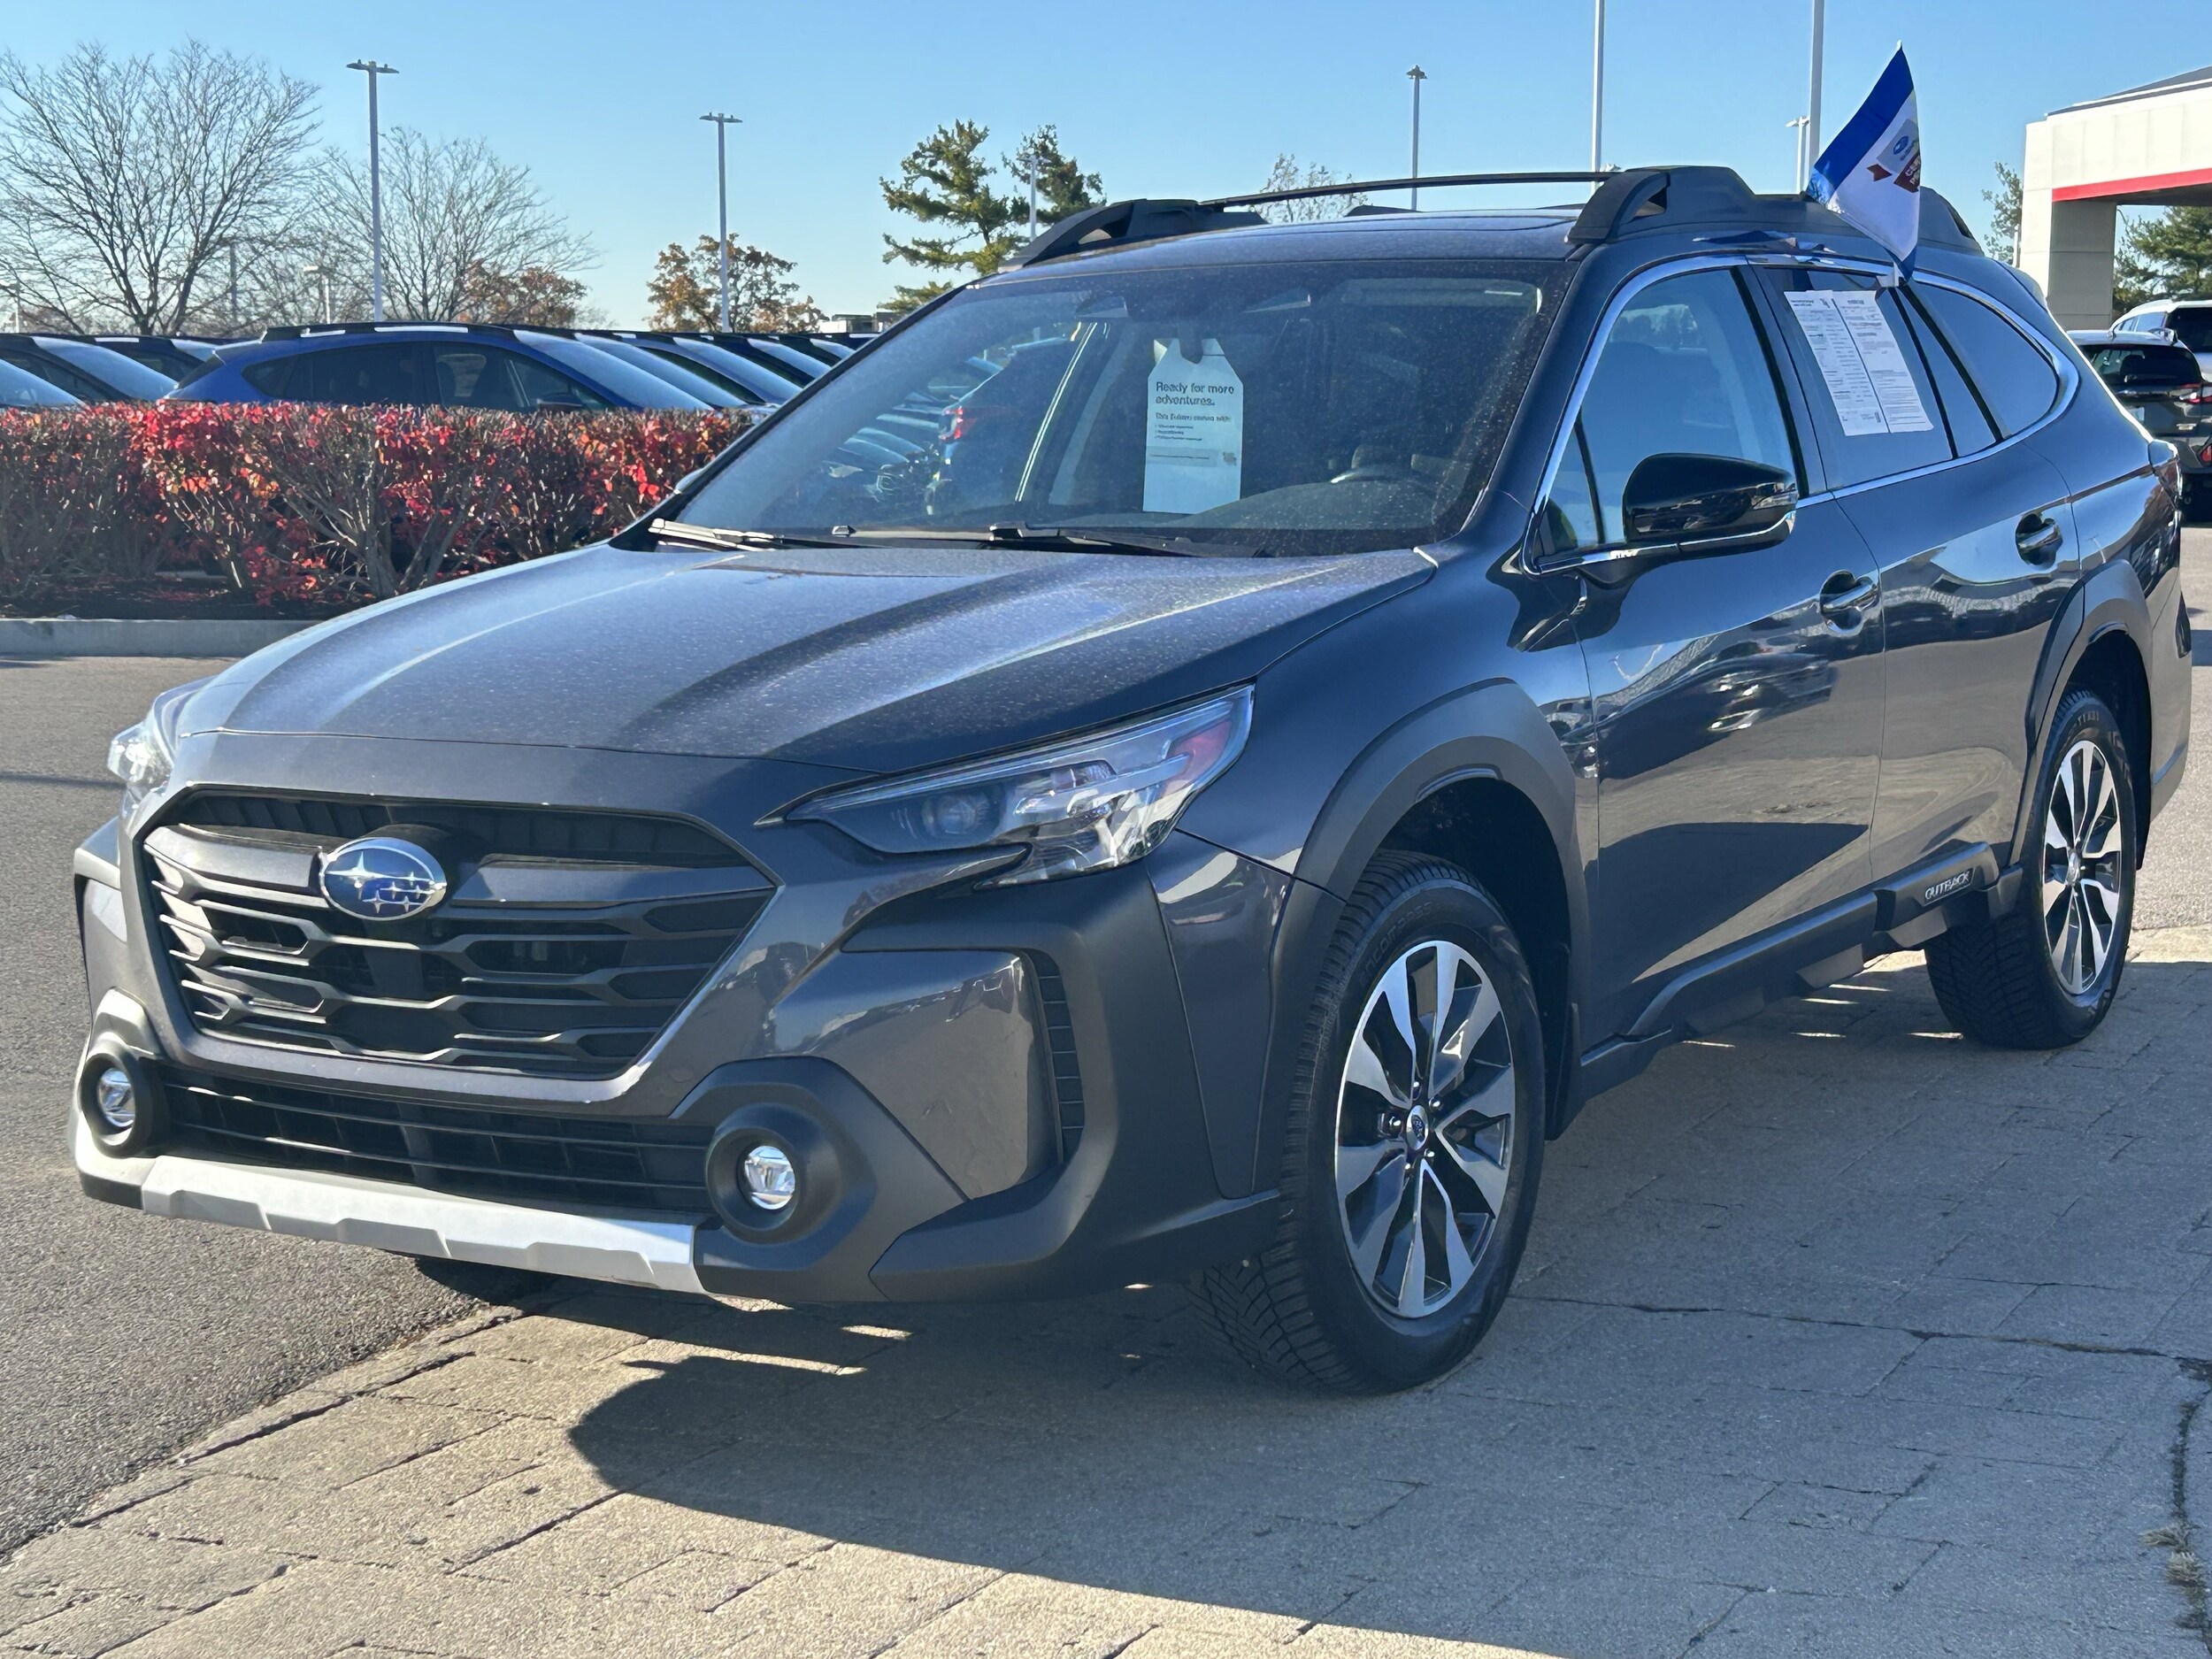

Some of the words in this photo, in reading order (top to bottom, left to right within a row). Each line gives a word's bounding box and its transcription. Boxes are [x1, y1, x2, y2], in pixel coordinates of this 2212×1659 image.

[1156, 381, 1188, 394] Ready
[1191, 382, 1205, 393] for
[1208, 385, 1234, 395] more
